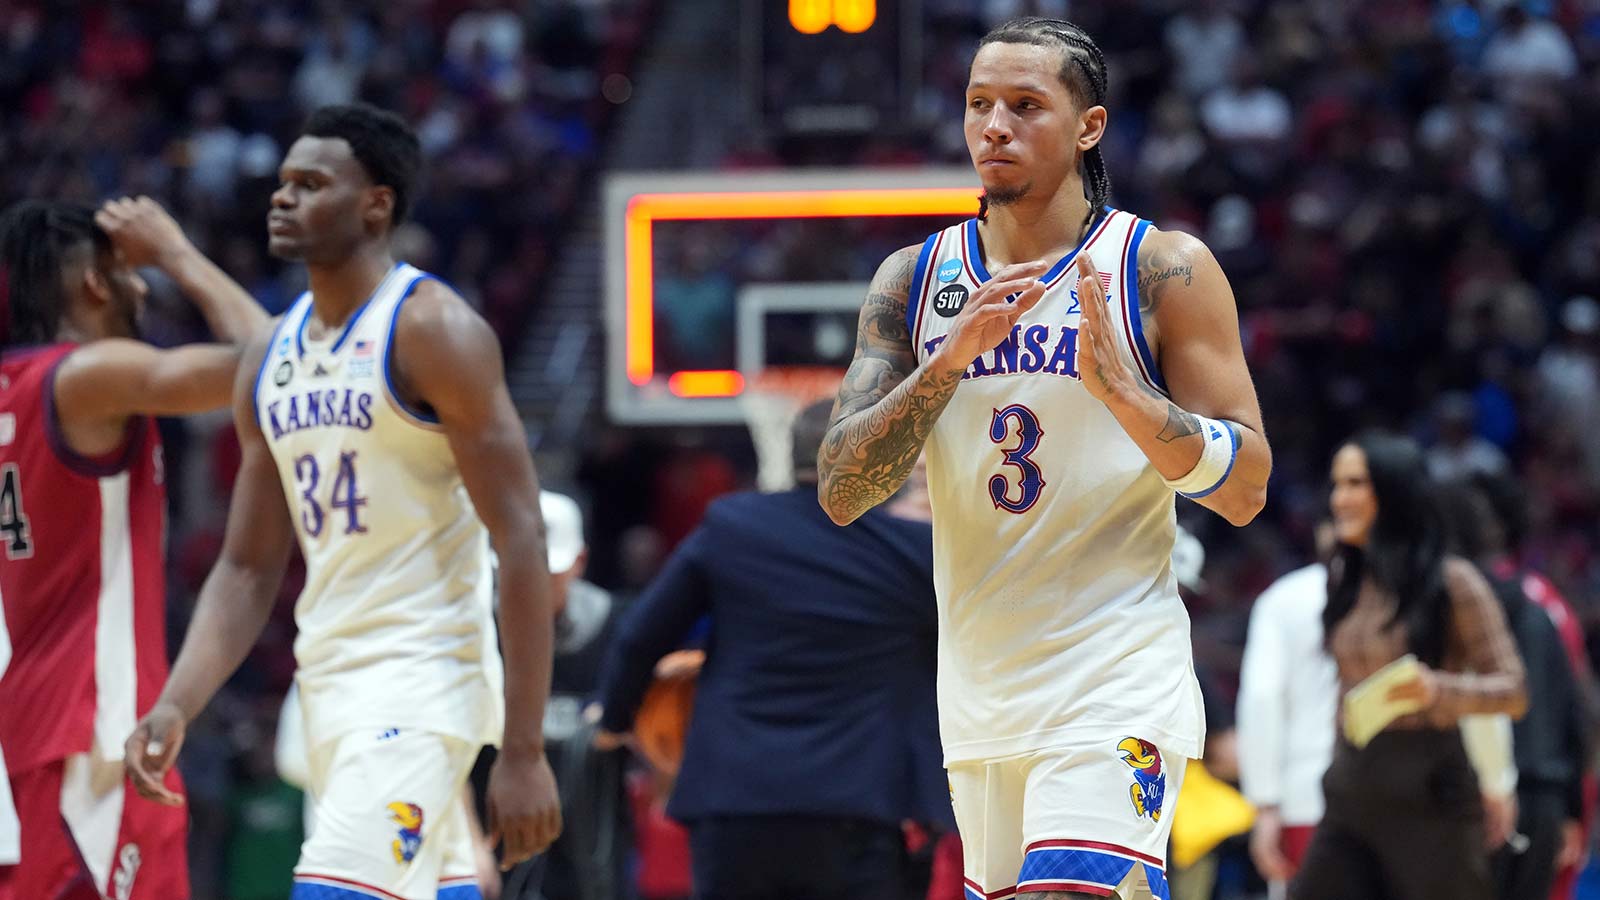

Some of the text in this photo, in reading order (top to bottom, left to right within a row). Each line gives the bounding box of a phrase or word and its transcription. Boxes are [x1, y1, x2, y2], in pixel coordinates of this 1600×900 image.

[940, 266, 961, 277] NCAA
[937, 291, 965, 309] SW
[267, 388, 373, 440] KANSAS
[988, 403, 1046, 515] 3
[294, 449, 369, 538] 34
[1147, 781, 1159, 800] KU
